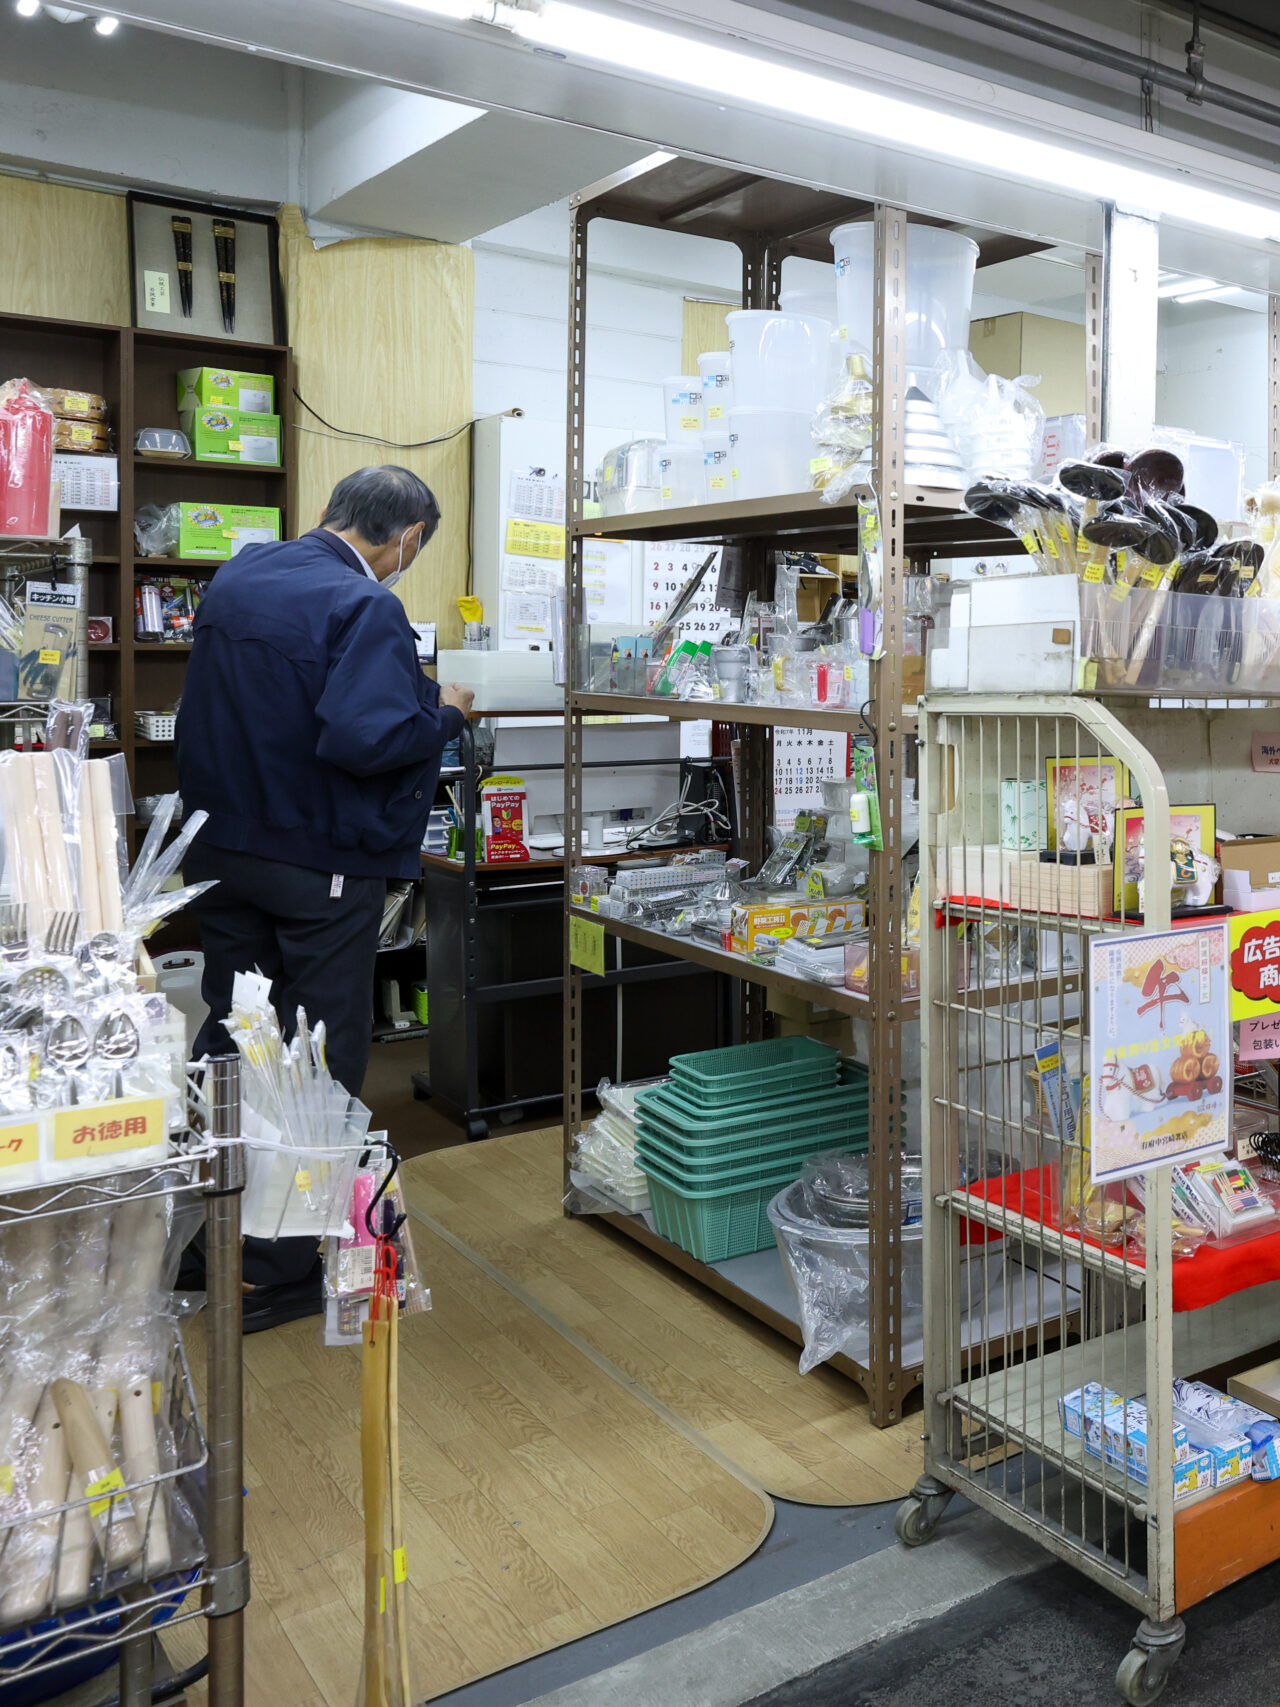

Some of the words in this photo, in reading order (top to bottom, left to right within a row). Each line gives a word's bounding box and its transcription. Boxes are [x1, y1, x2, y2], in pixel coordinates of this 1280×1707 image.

[653, 562, 660, 571] 2
[668, 562, 674, 571] 3
[681, 563, 688, 572] 4
[710, 564, 717, 573] 6
[652, 581, 659, 590] 9
[665, 582, 677, 591] 10
[650, 602, 661, 610] 16
[694, 603, 706, 611] 19
[708, 604, 721, 612] 20
[29, 614, 51, 622] CHEESE
[52, 616, 73, 624] CUTTER
[680, 622, 691, 630] 25
[694, 622, 706, 631] 26
[709, 622, 720, 631] 27
[776, 758, 781, 766] 3
[818, 757, 822, 765] 7
[775, 768, 783, 776] 10
[796, 767, 803, 775] 12
[826, 766, 834, 774] 15
[785, 777, 793, 785] 18
[796, 777, 803, 785] 19
[774, 787, 782, 795] 24
[795, 786, 803, 794] 26
[72, 1116, 147, 1145] お徳用
